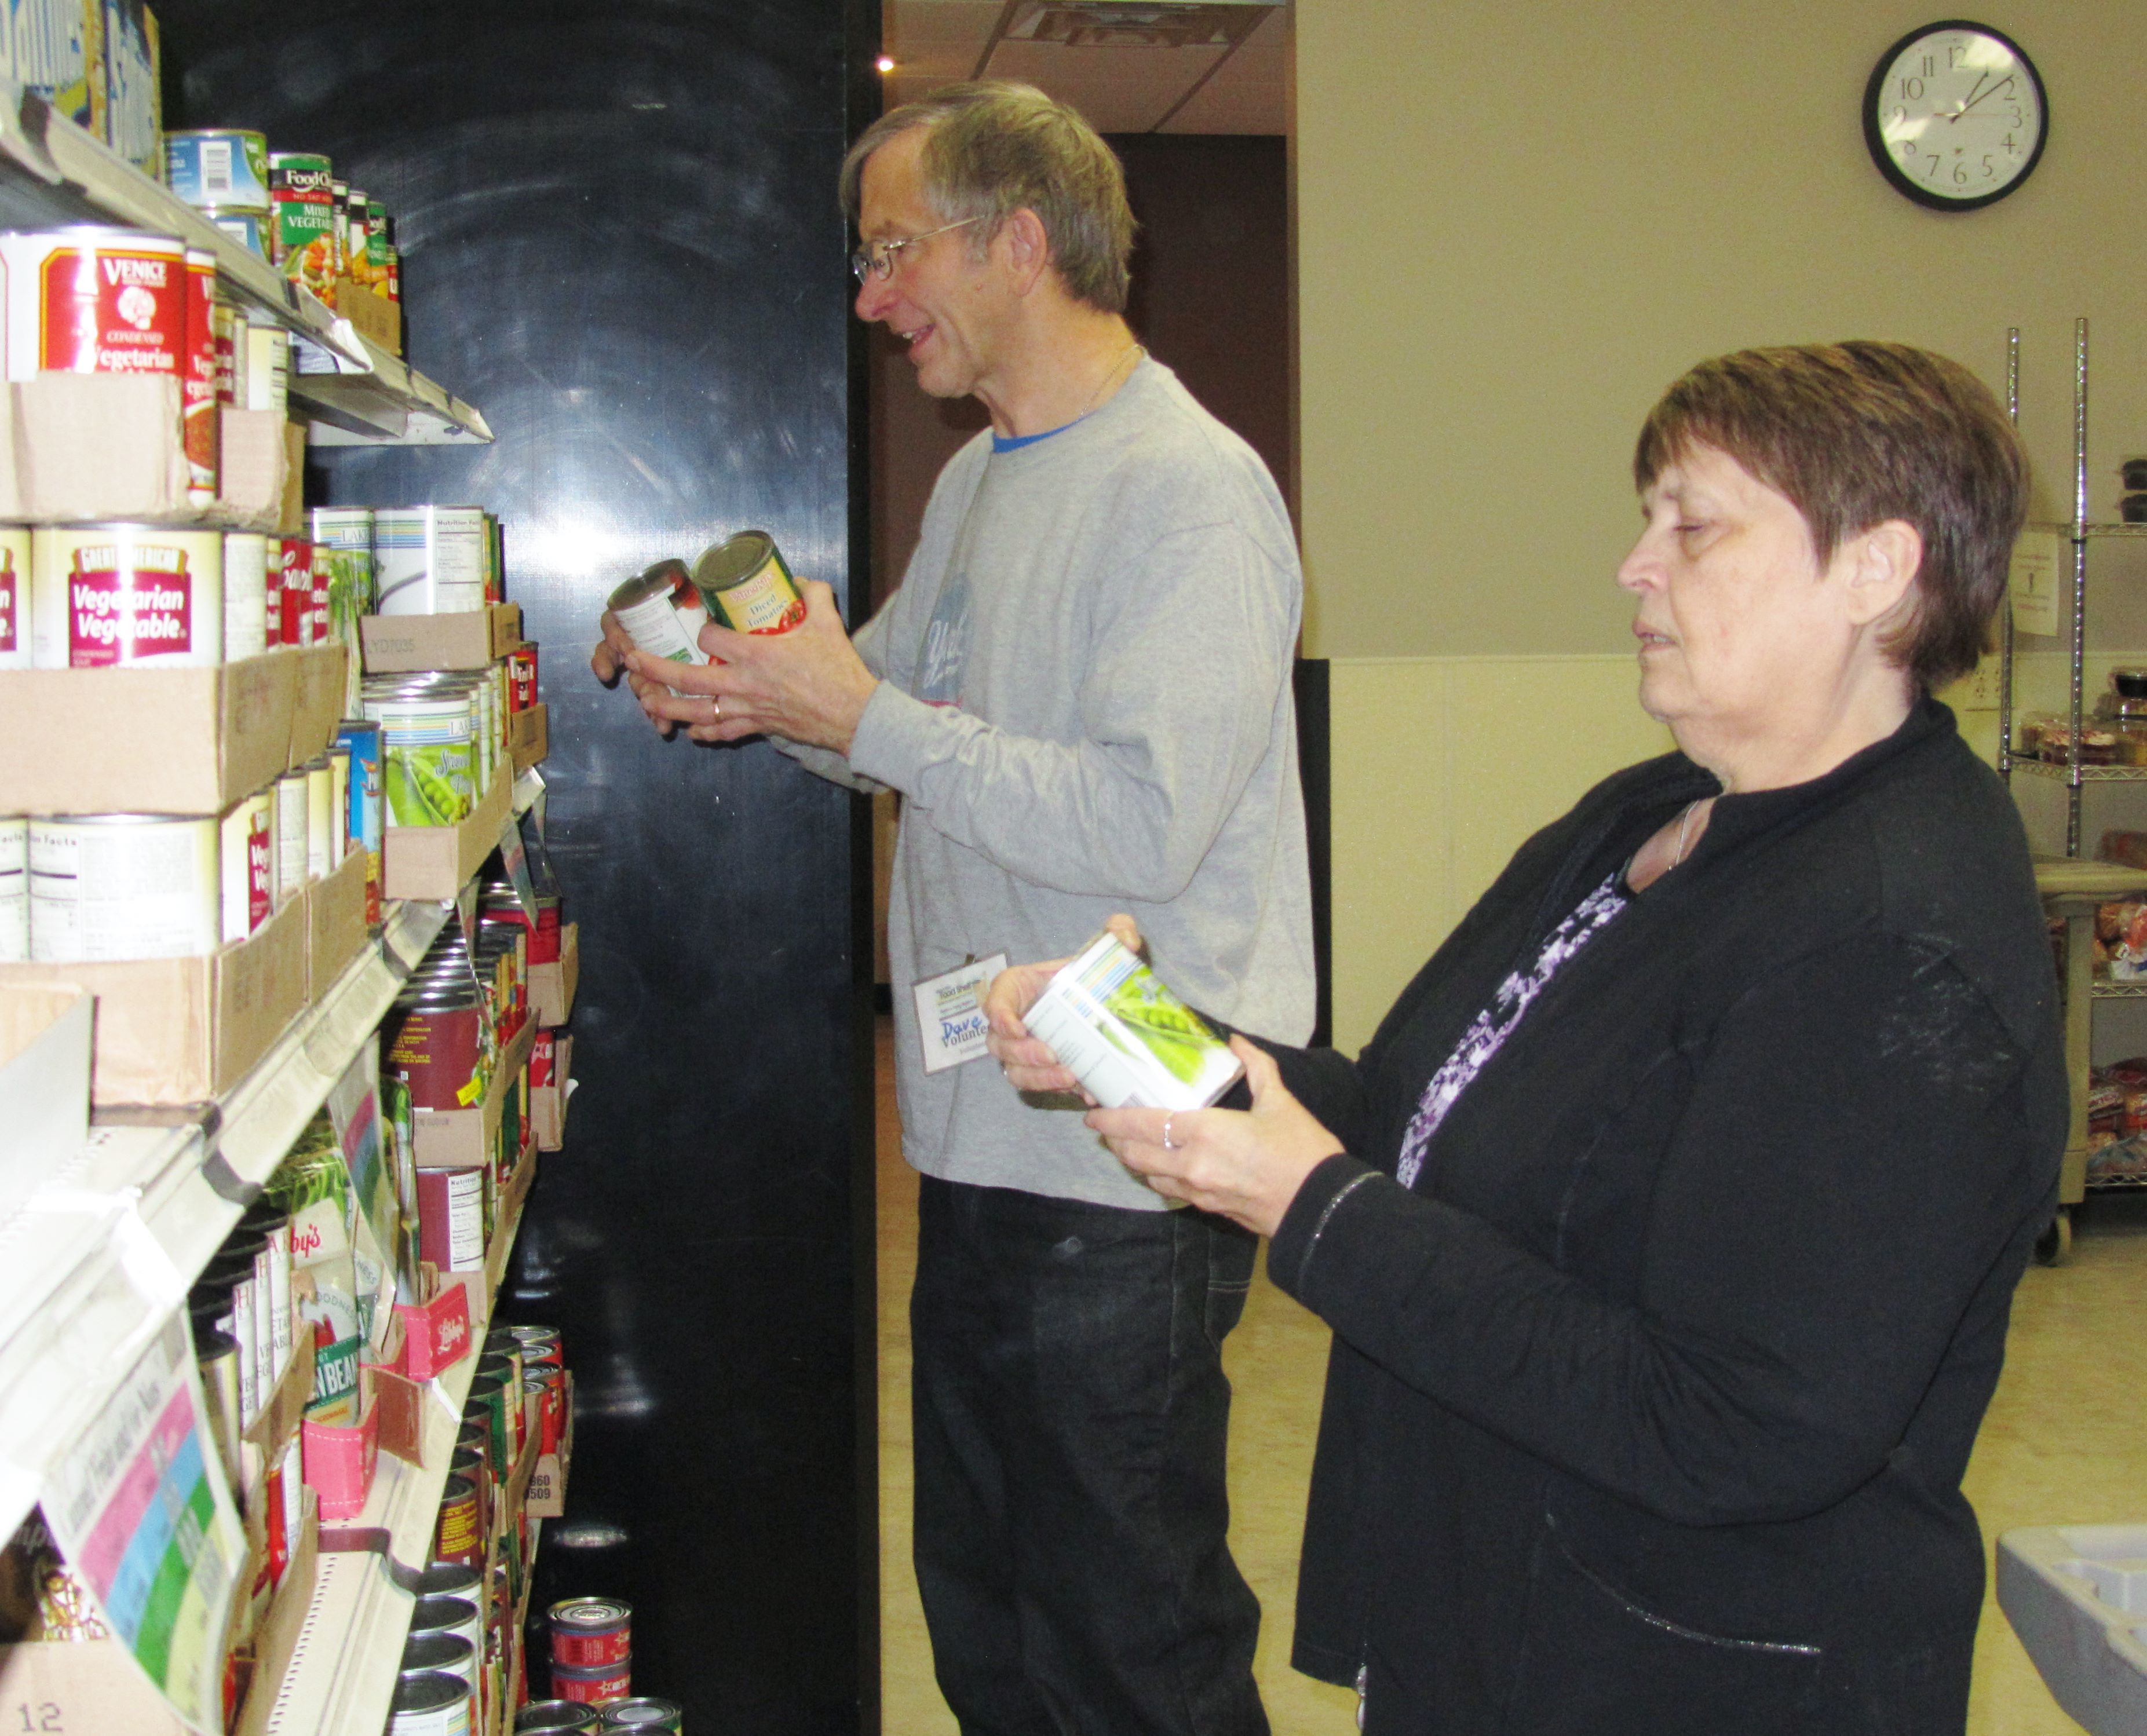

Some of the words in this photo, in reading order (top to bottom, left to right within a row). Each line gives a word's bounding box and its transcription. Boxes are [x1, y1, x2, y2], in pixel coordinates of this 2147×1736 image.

[1922, 55, 1934, 77] 11
[1948, 46, 1967, 69] 12
[1900, 77, 1924, 100] 10
[2003, 77, 2017, 101] 2
[2010, 105, 2022, 129] 3
[2000, 132, 2016, 155] 4
[1926, 154, 1940, 177] 7
[1953, 162, 1967, 184] 6
[1982, 155, 1993, 177] 5
[103, 258, 167, 286] VENICE
[74, 583, 185, 616] Vegearian
[750, 594, 776, 615] Diced
[78, 612, 181, 645] Vegable
[941, 1016, 983, 1039] Dave
[941, 1024, 989, 1048] Volunte
[290, 1223, 321, 1258] by's
[324, 1353, 357, 1395] BEAN
[18, 1702, 64, 1733] 12
